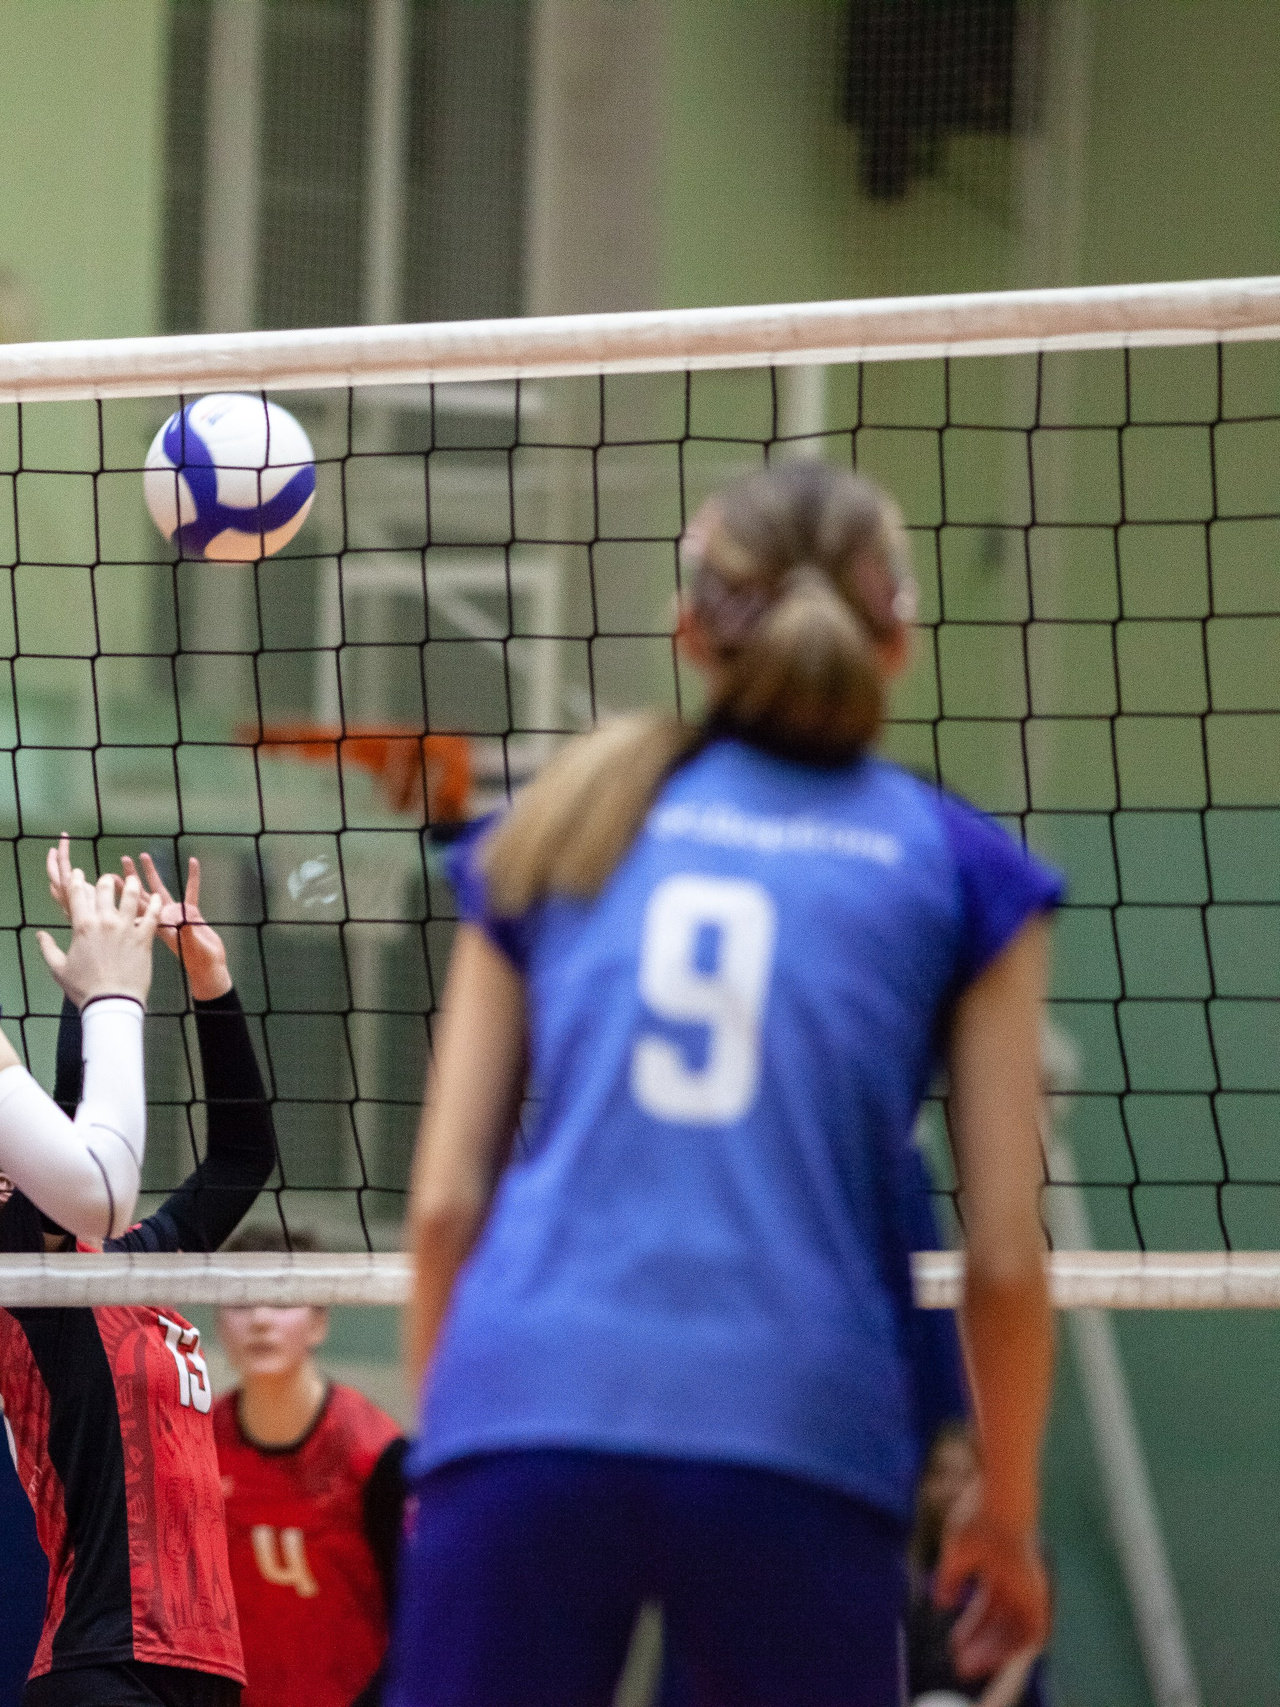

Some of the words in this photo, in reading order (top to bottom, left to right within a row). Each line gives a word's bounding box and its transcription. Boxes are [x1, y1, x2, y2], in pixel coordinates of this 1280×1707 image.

[631, 873, 777, 1126] 9
[158, 1314, 212, 1414] 13
[251, 1524, 320, 1599] 4
